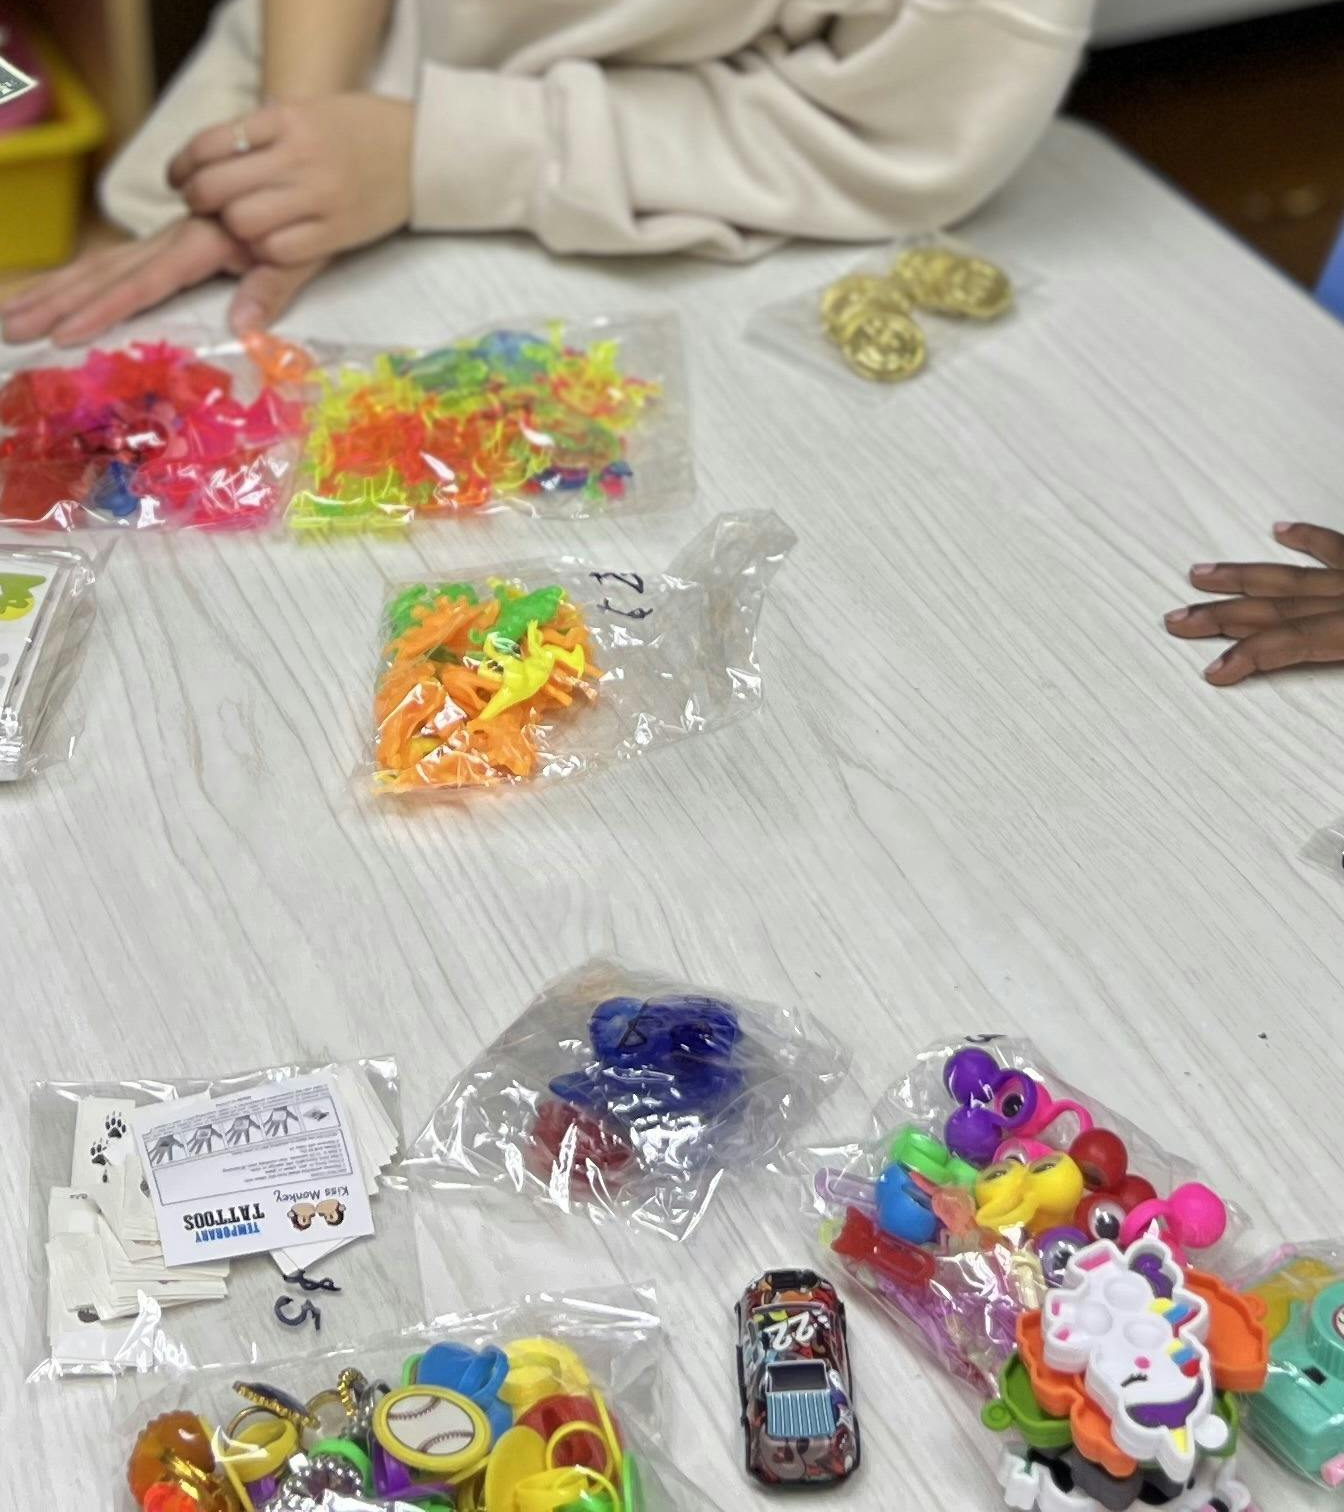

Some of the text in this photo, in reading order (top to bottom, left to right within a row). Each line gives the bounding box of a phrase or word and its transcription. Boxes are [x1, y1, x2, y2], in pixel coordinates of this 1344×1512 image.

[273, 1185, 350, 1203] Kiss Monkey
[183, 1202, 265, 1231] TATTOOS
[195, 1222, 260, 1243] TEMPORARY
[762, 1311, 815, 1351] 22
